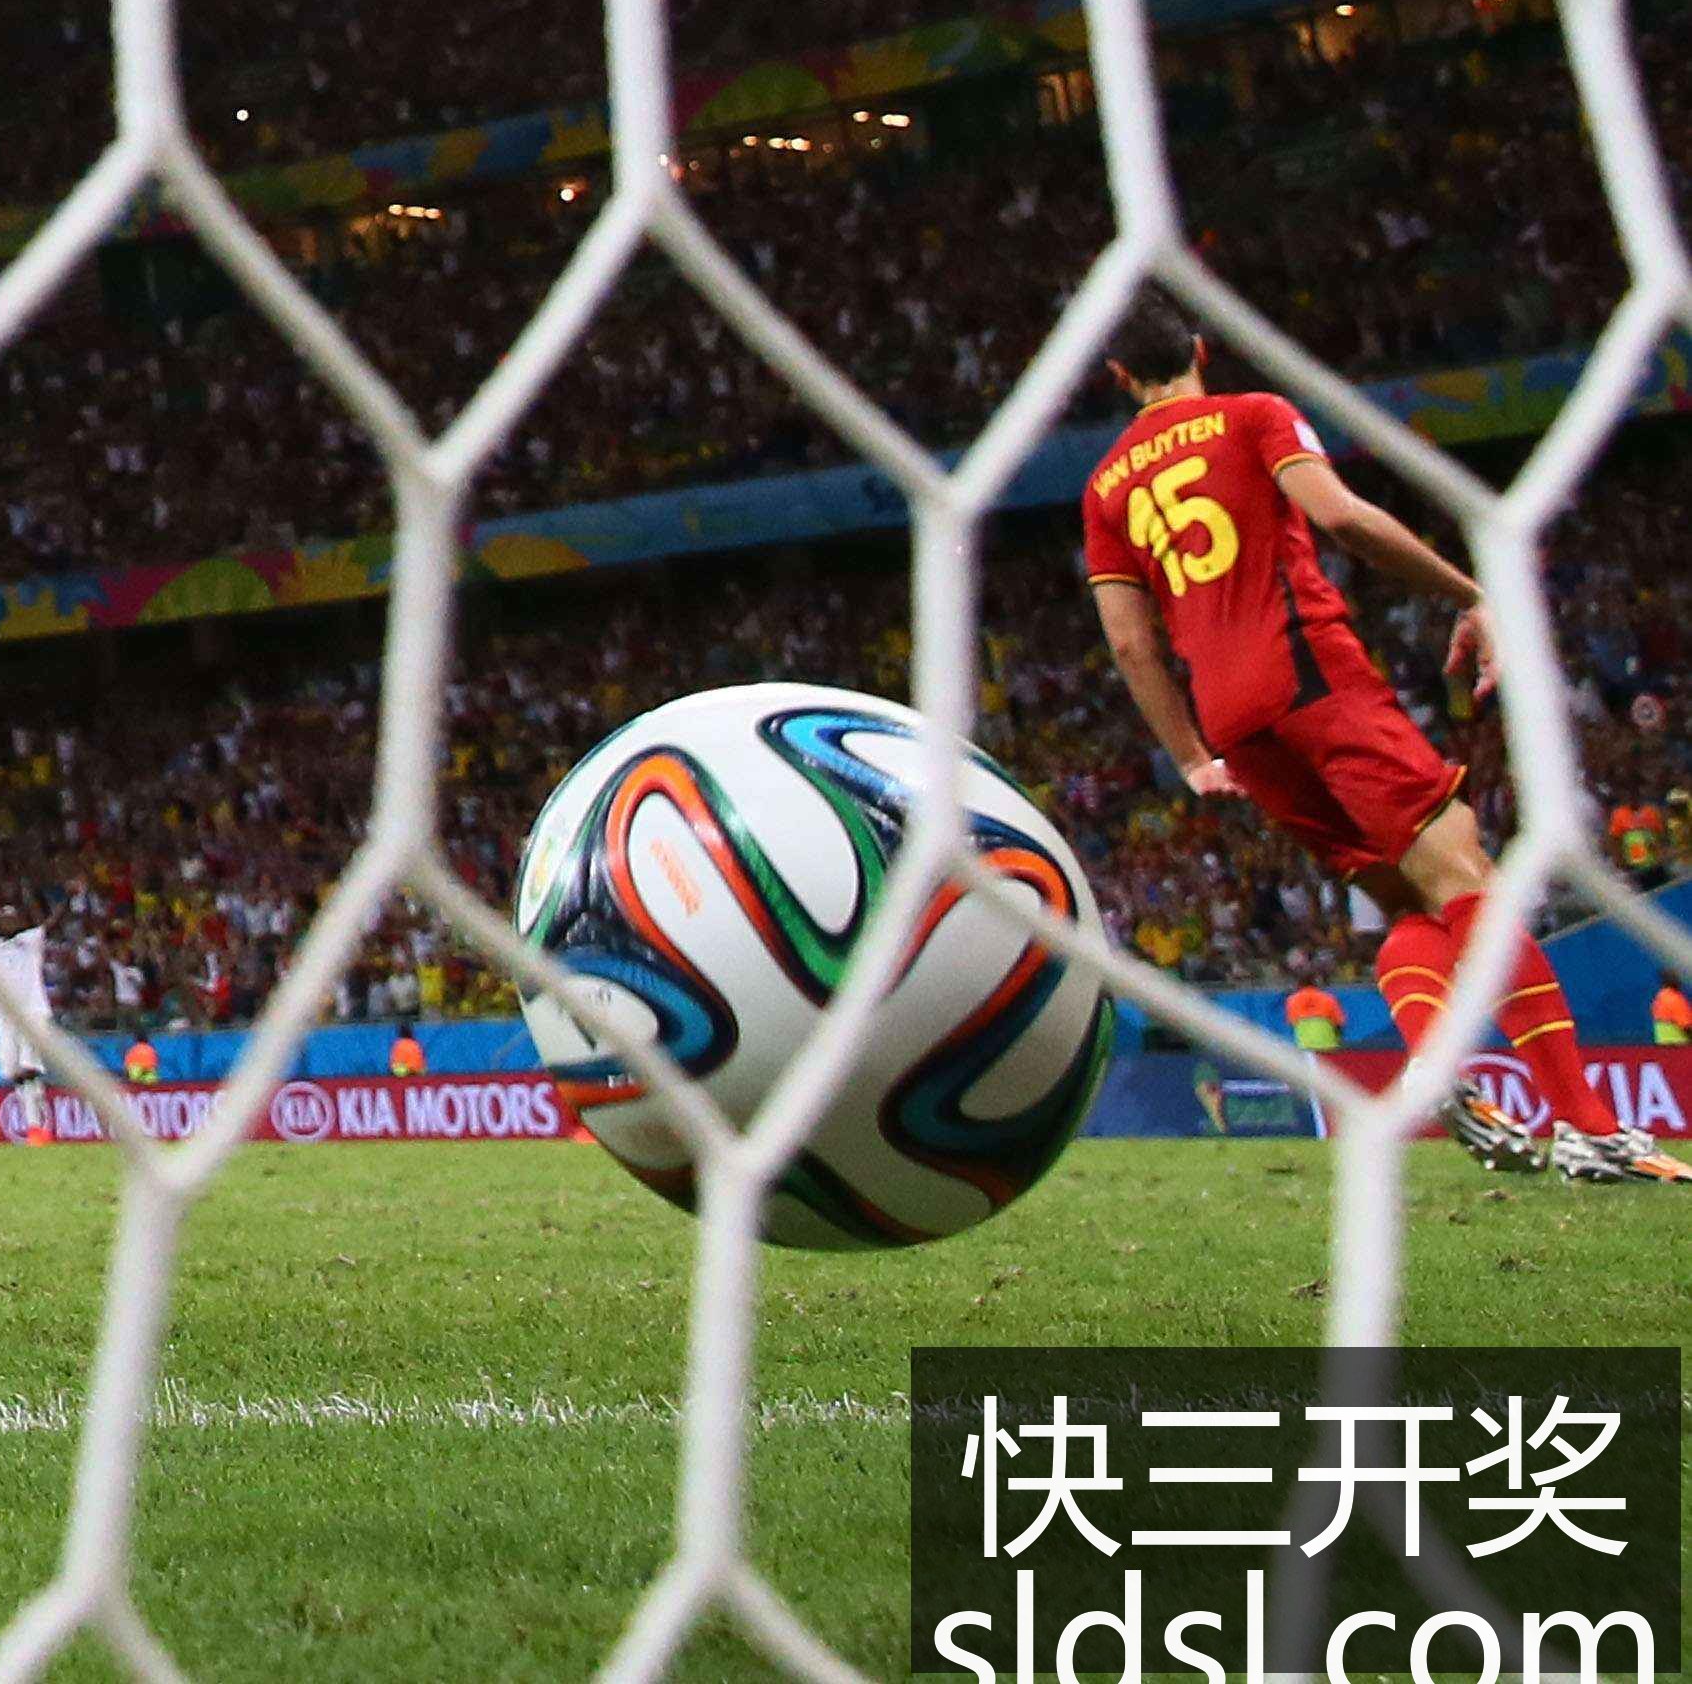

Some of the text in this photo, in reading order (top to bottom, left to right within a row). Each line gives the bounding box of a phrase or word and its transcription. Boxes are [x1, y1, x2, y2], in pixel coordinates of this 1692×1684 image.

[1129, 411, 1226, 473] BUYTEN
[1127, 454, 1240, 597] 15
[336, 1085, 400, 1138] KIA
[404, 1081, 560, 1138] MOTORS
